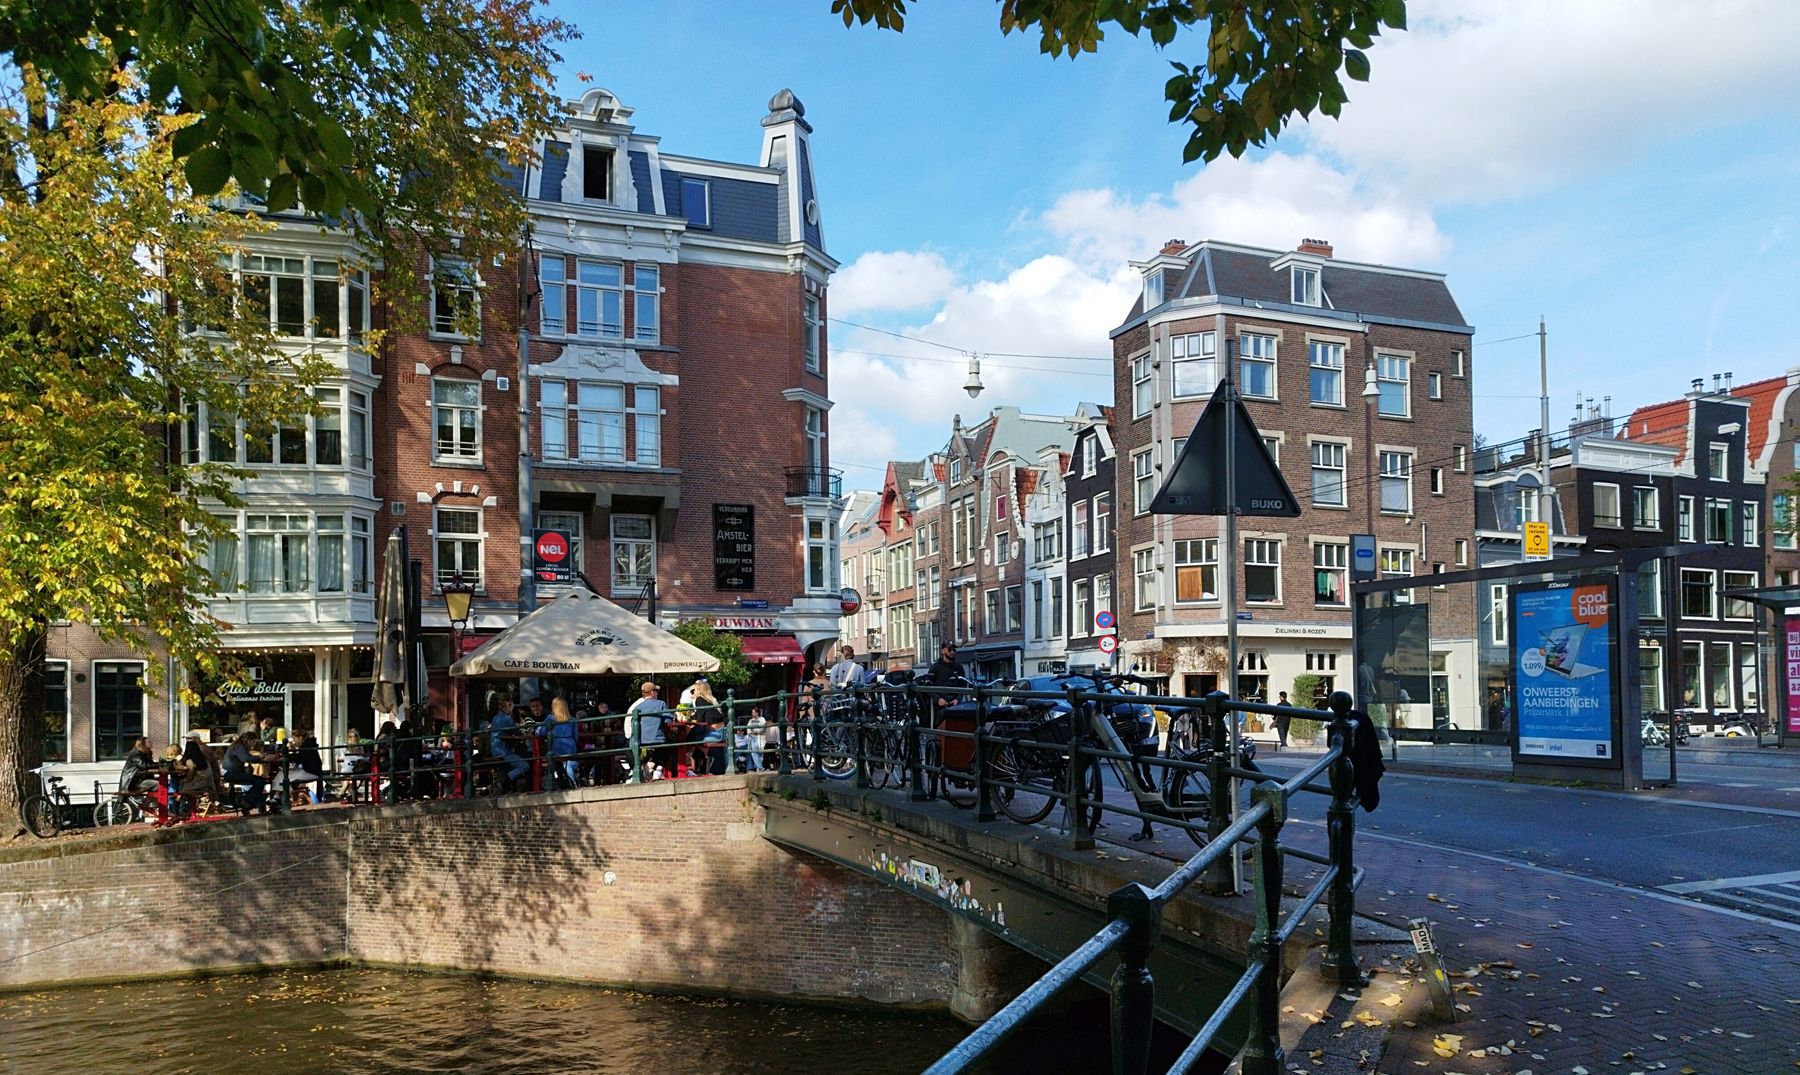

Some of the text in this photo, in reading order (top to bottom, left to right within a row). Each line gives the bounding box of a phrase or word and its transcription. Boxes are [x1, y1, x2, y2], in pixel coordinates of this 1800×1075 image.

[1251, 500, 1283, 509] BUKO
[736, 543, 752, 552] BIER
[1578, 590, 1607, 604] cool
[1579, 605, 1608, 616] blue
[1789, 634, 1798, 643] Bij
[1790, 647, 1800, 658] vi
[504, 660, 580, 670] CAFÉ BOUWMAN
[663, 661, 698, 669] BROUWERIJ
[254, 682, 289, 694] Bella
[1523, 697, 1599, 708] AANBIEDINGEN
[1418, 930, 1430, 950] MAD
